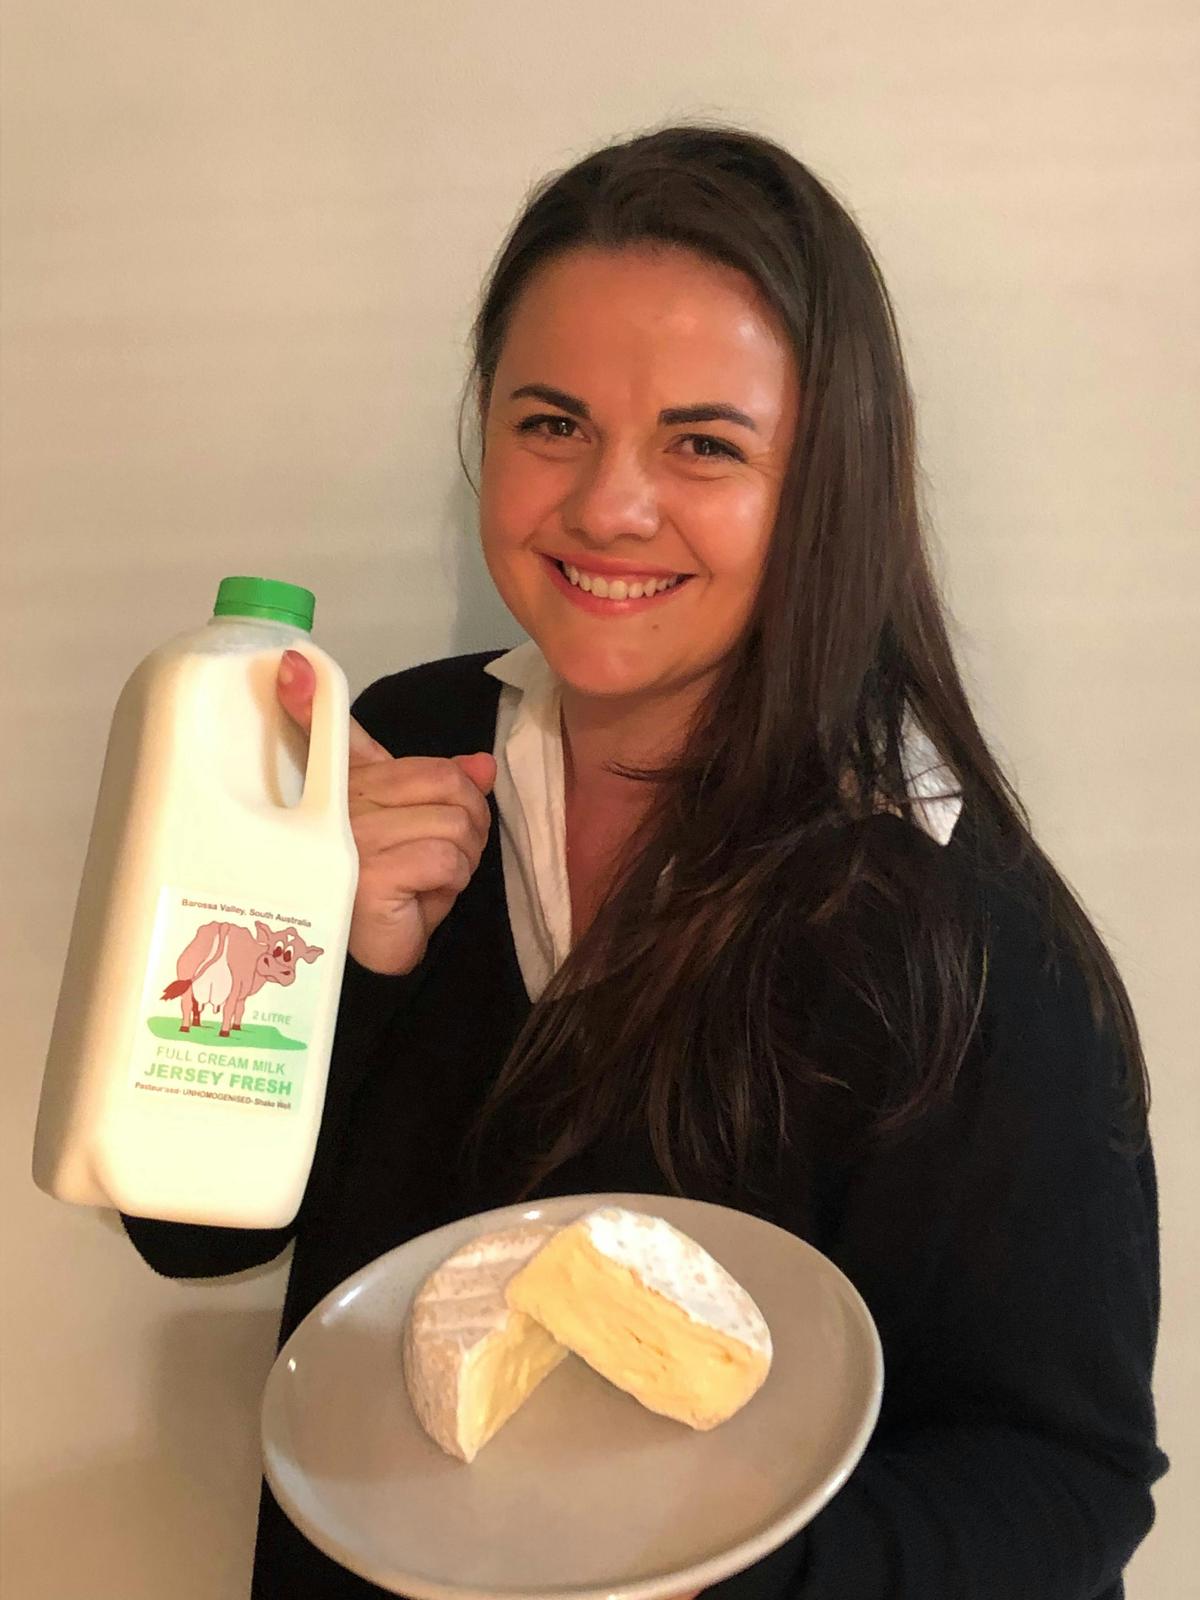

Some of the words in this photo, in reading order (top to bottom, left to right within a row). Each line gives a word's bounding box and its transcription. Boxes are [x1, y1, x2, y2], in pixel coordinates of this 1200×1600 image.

[182, 899, 218, 910] Barossa
[249, 908, 274, 920] South
[275, 913, 312, 927] Australia
[252, 1010, 260, 1020] 2
[261, 1012, 292, 1025] LITRE
[156, 1046, 192, 1062] FULL
[197, 1051, 249, 1070] CREAM
[252, 1060, 286, 1076] MILK
[144, 1063, 224, 1086] JERSEY
[229, 1073, 292, 1096] FRESH
